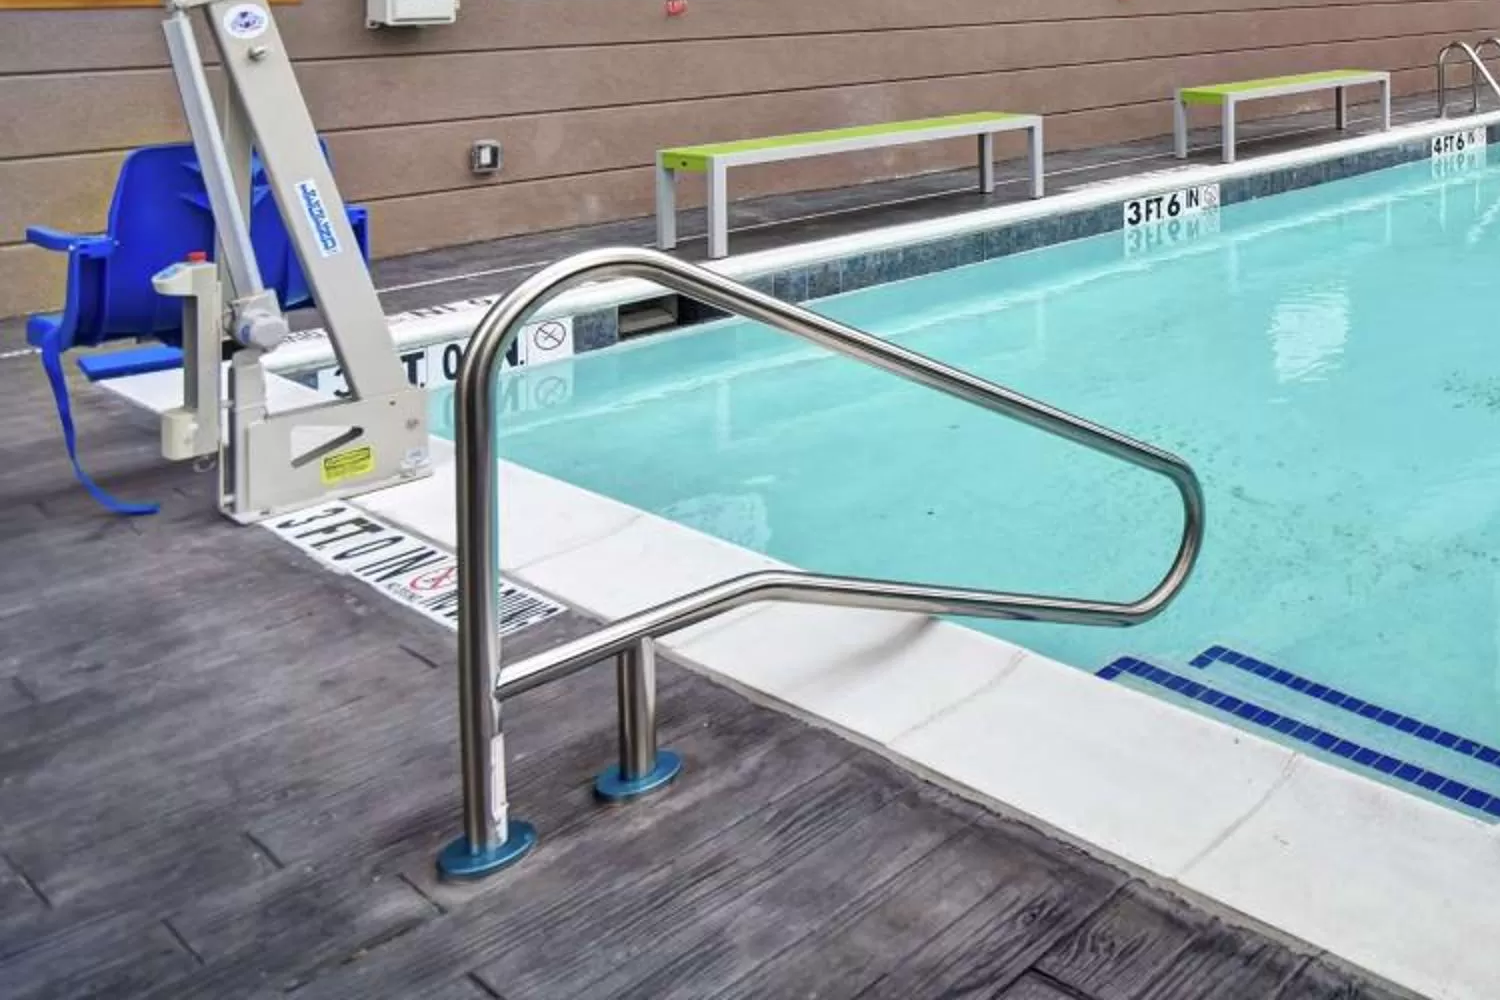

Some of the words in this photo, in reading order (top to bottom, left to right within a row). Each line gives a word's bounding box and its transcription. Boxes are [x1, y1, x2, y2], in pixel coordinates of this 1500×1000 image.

[1434, 137, 1442, 154] 4
[1444, 135, 1454, 152] FT
[1456, 132, 1465, 151] 6
[1127, 201, 1142, 225] 3
[1167, 194, 1181, 217] 6
[1186, 187, 1199, 208] IN
[276, 507, 347, 529] 3
[354, 546, 450, 582] IN
